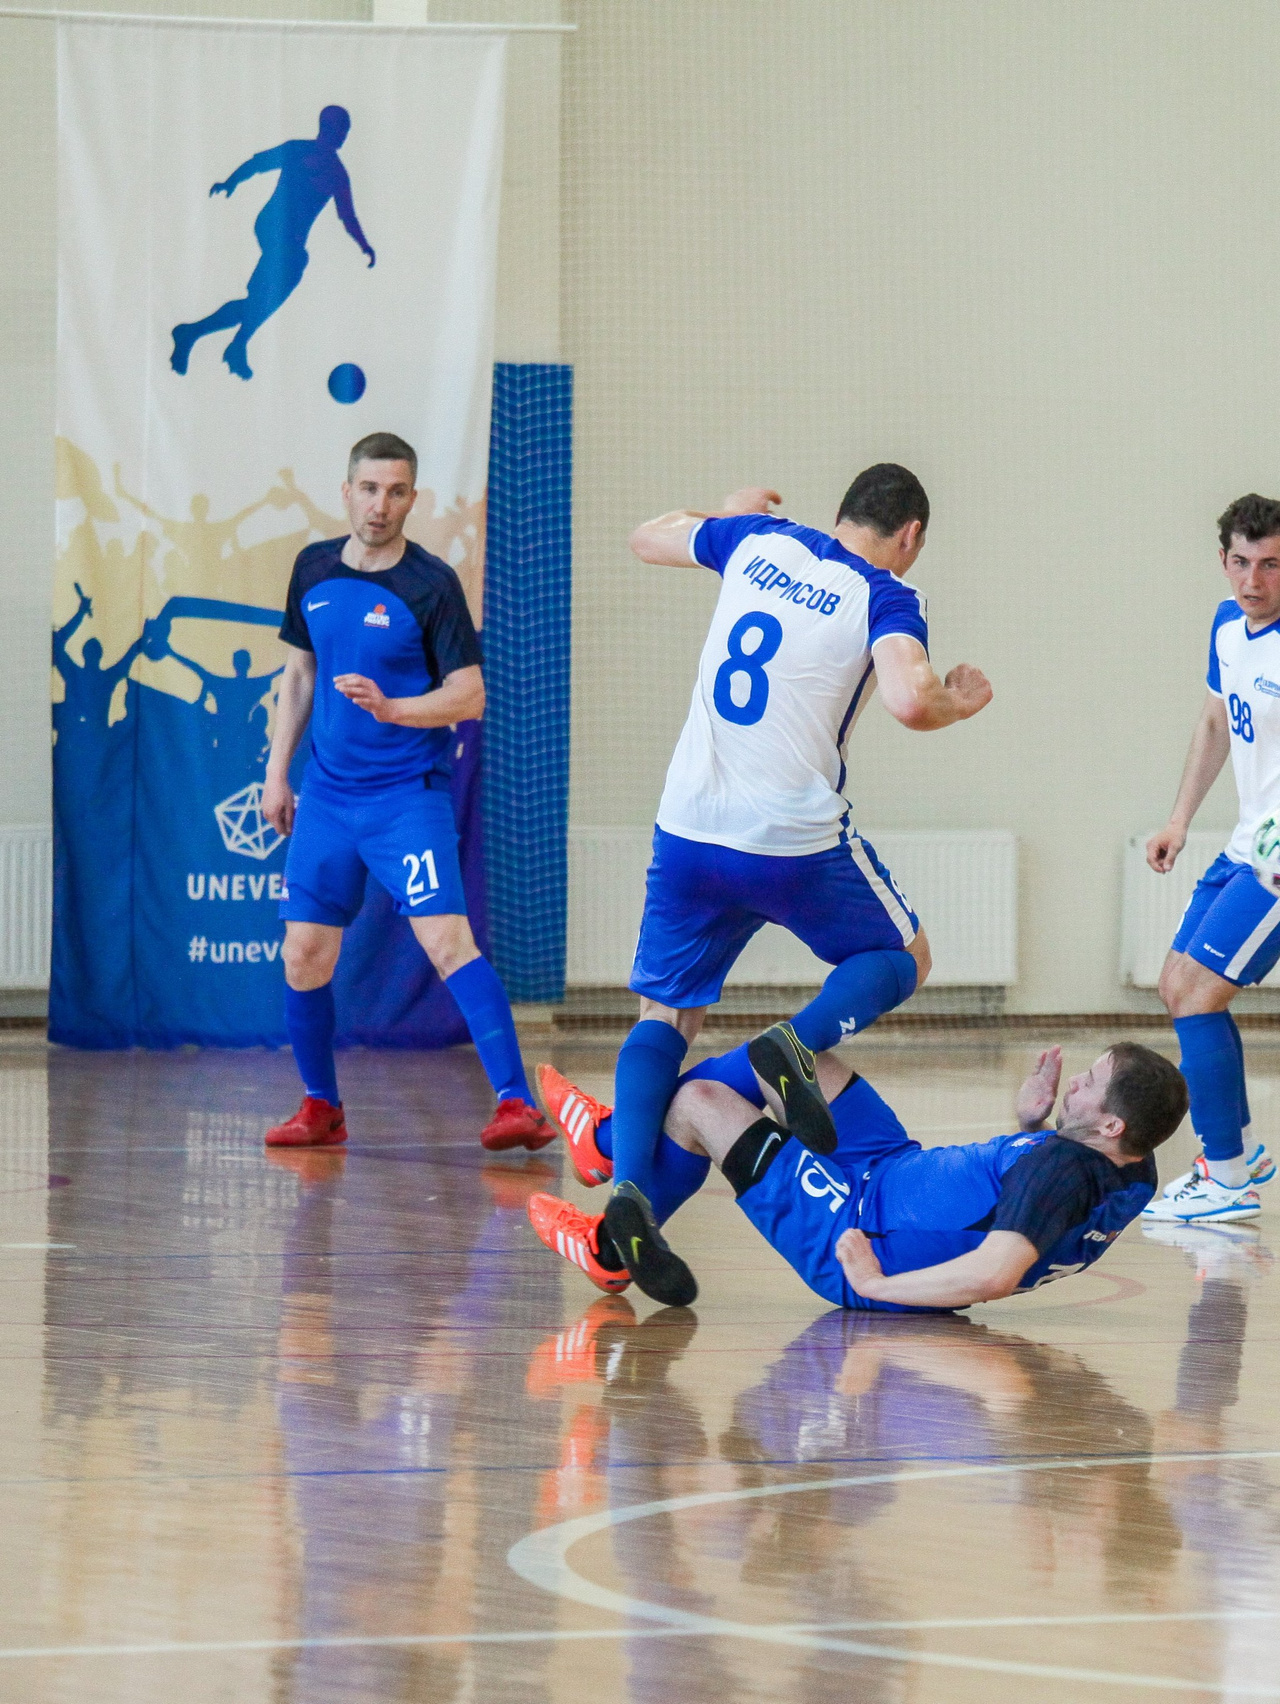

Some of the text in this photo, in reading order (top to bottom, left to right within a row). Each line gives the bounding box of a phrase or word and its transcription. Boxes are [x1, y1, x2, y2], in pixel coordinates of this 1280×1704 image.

[742, 555, 841, 616] ИДРИСОВ
[713, 611, 783, 726] 8
[1229, 693, 1254, 743] 98
[402, 849, 440, 896] 21
[801, 1160, 851, 1213] 15
